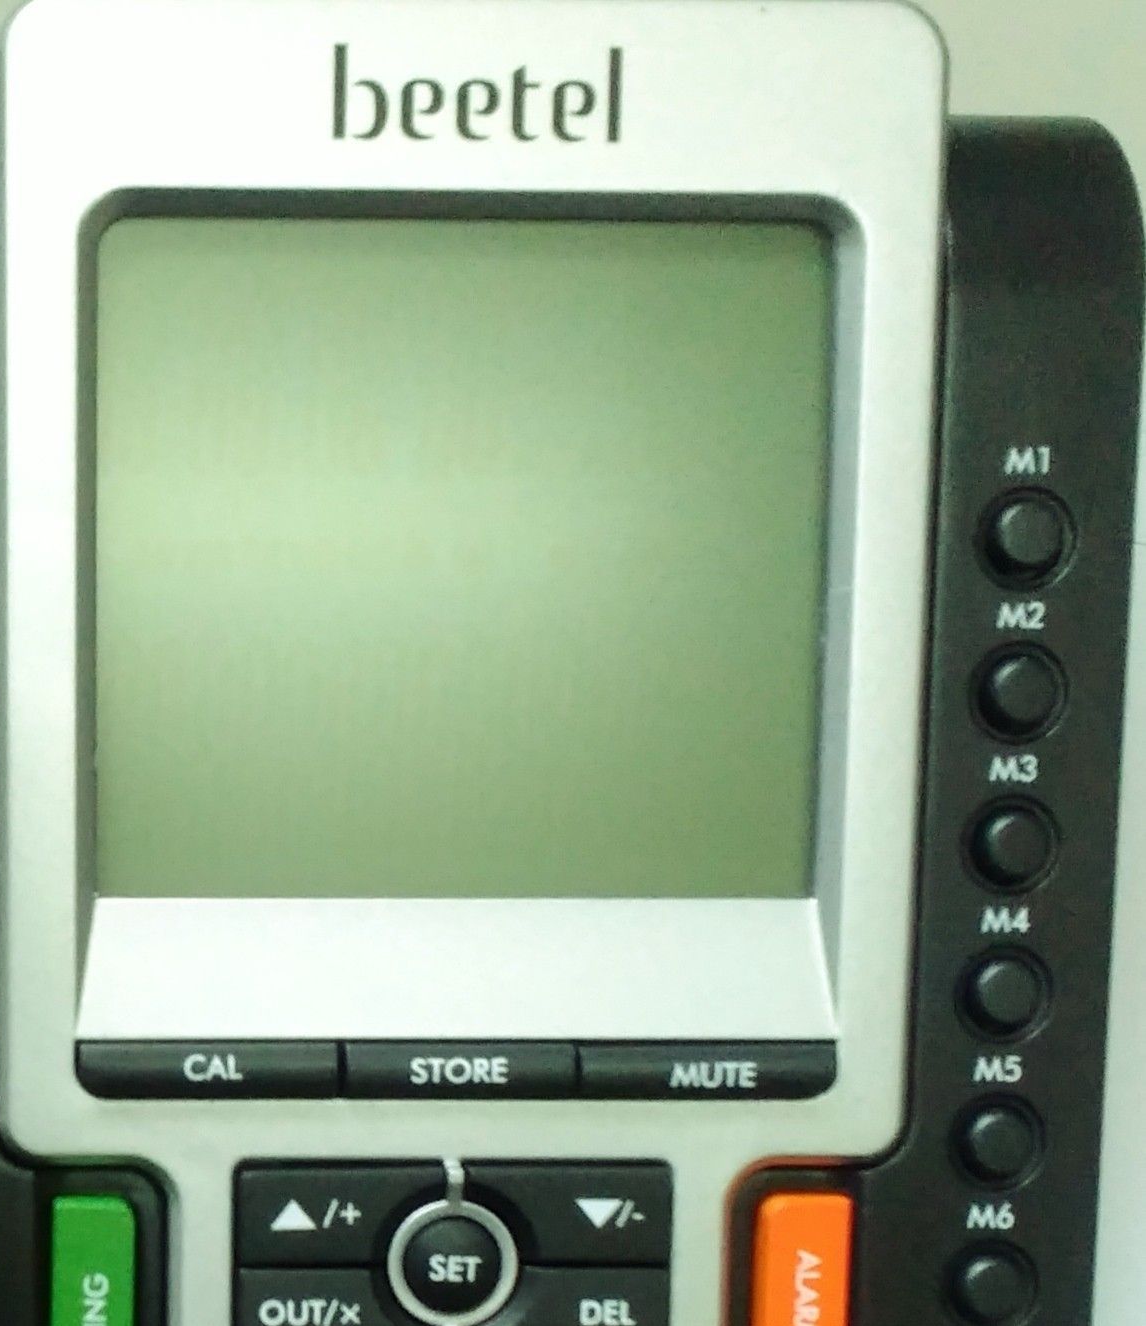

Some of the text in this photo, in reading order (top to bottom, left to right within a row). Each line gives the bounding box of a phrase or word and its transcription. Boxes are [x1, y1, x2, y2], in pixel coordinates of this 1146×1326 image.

[332, 43, 622, 143] beetel
[1004, 446, 1052, 474] M1
[996, 602, 1044, 630] M2
[988, 756, 1038, 782] M3
[980, 908, 1030, 933] M4
[183, 1055, 242, 1083] CAL
[410, 1057, 509, 1085] STORE
[669, 1060, 758, 1089] MUTE
[972, 1058, 1023, 1082] M5
[966, 1204, 1014, 1229] M6
[429, 1257, 481, 1283] SET
[579, 1300, 633, 1326] DEL
